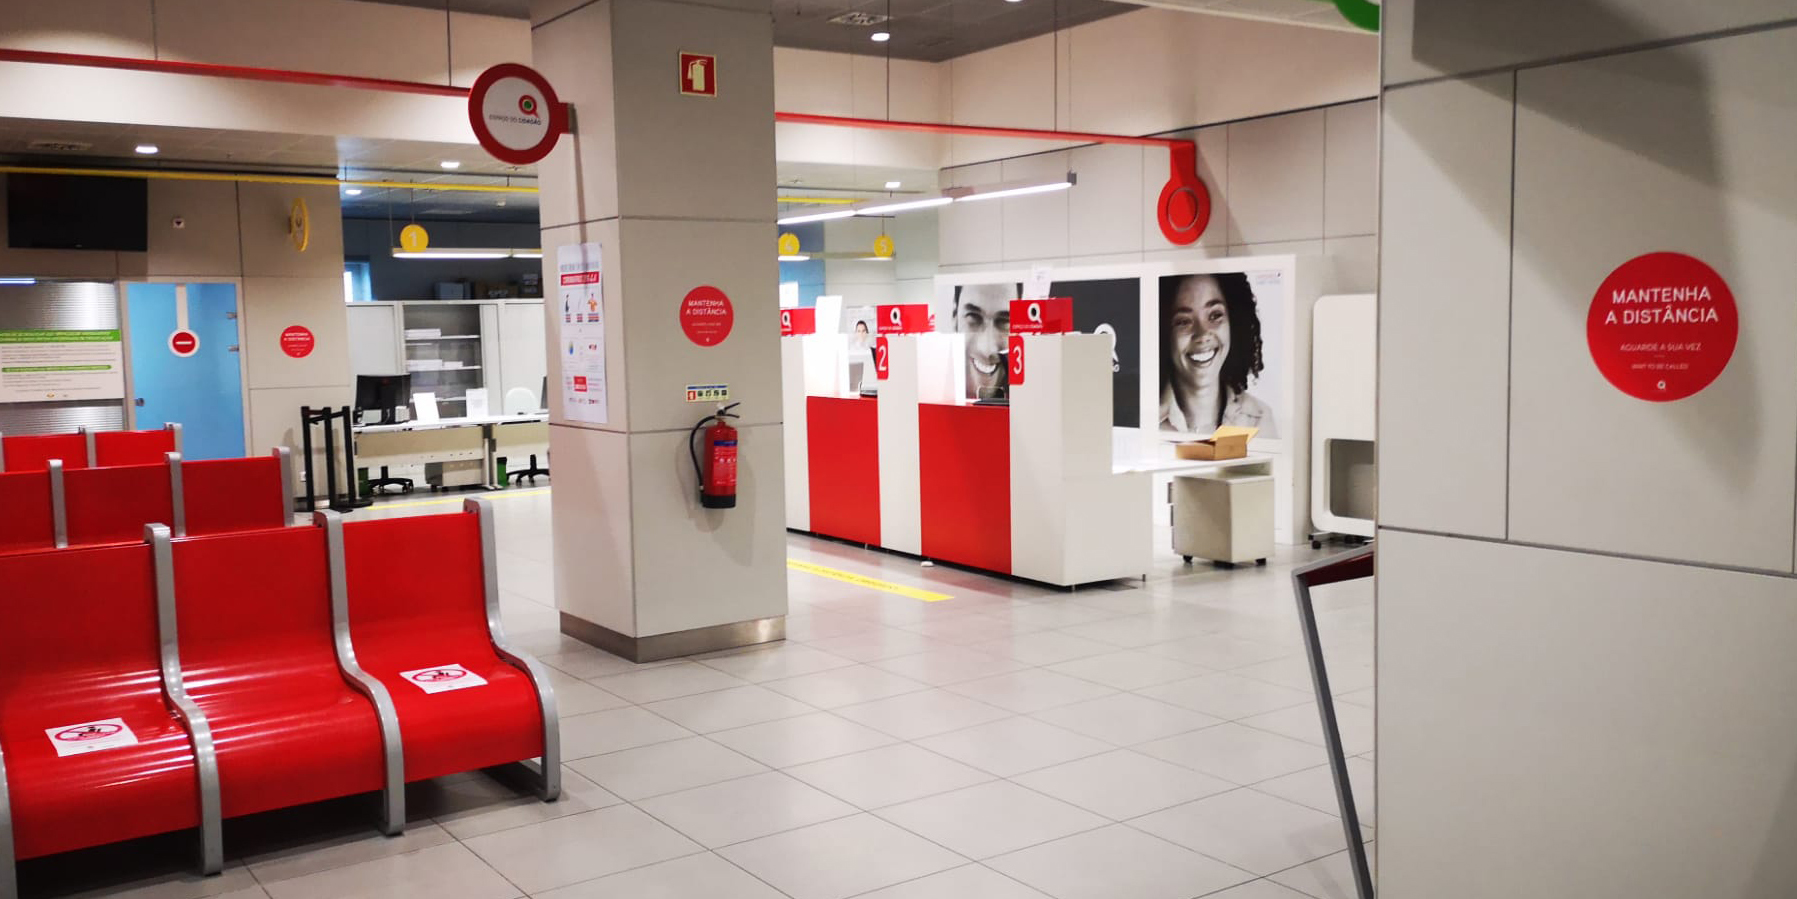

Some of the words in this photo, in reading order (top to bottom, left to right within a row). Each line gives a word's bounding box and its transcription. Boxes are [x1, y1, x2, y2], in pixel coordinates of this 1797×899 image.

[410, 231, 418, 247] 1
[688, 299, 724, 307] MANTENHA
[1612, 286, 1711, 304] MANTENHA
[686, 308, 691, 316] A
[1605, 310, 1618, 325] A
[1622, 304, 1719, 324] DISTÂNCIA
[1620, 342, 1658, 352] AGUARDE
[1684, 341, 1702, 351] VEZ
[878, 345, 887, 372] 2
[1013, 345, 1022, 375] 3
